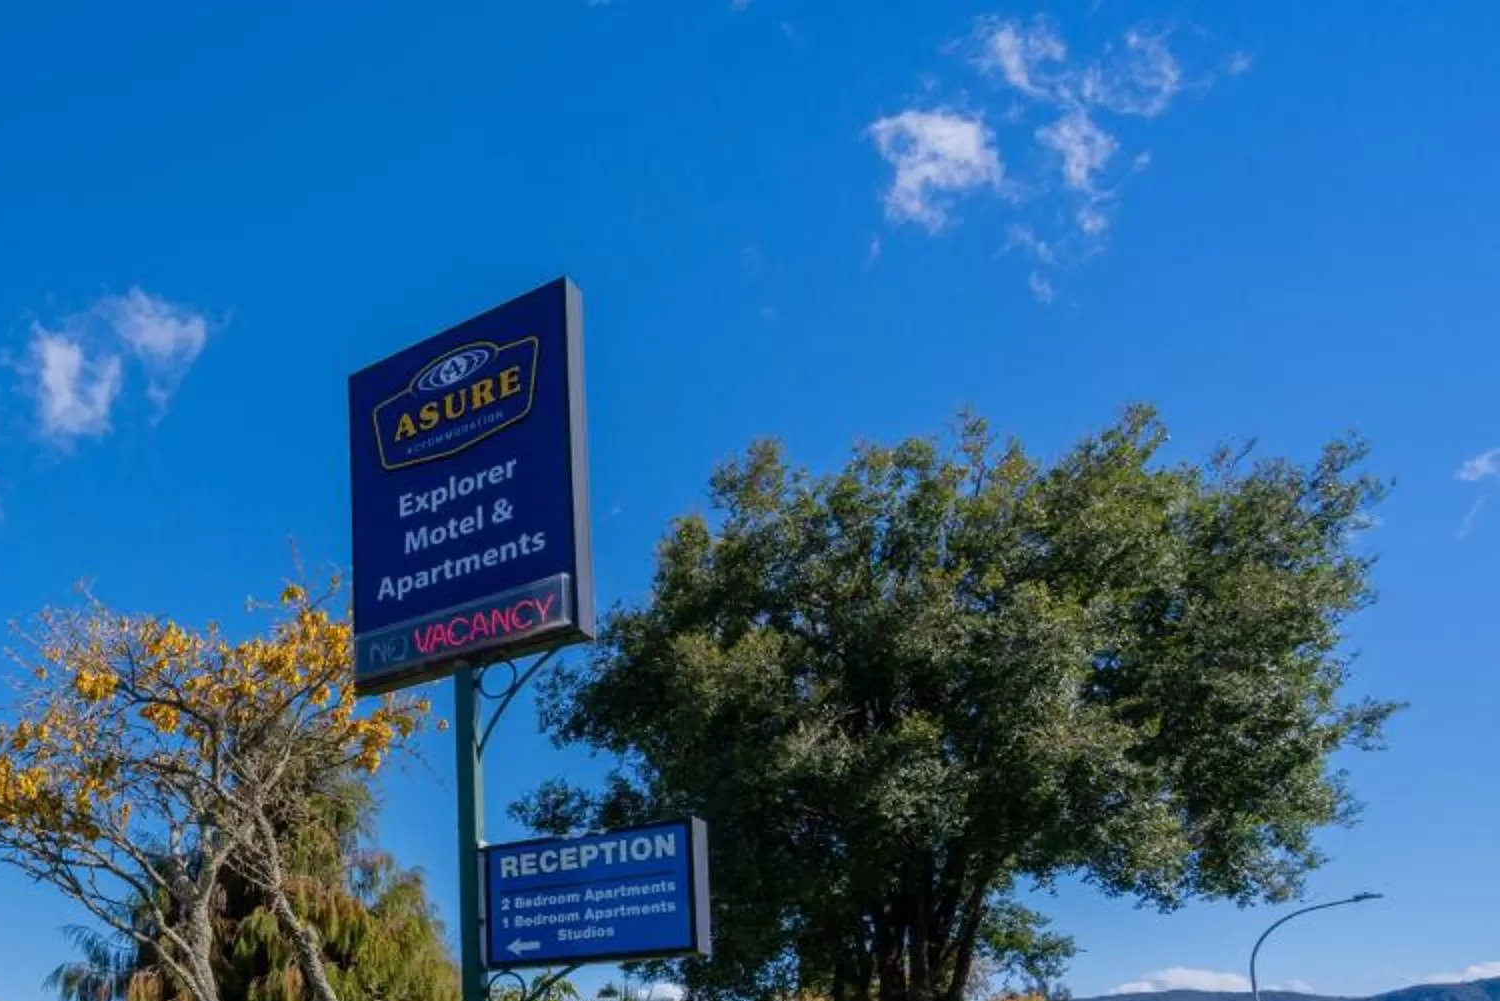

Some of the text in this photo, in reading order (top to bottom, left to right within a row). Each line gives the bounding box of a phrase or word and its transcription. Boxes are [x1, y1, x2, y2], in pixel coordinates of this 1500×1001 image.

[394, 365, 521, 442] ASURE
[399, 458, 517, 518] Explorer
[404, 498, 514, 554] Motel &
[377, 531, 546, 601] Apartments
[369, 594, 555, 664] NO VACANCY
[500, 832, 676, 879] RECEPTION
[501, 880, 676, 911] 2 Bedroom Apartments
[502, 900, 676, 929] 1 Bedroom Apartments
[557, 925, 615, 942] Studios
